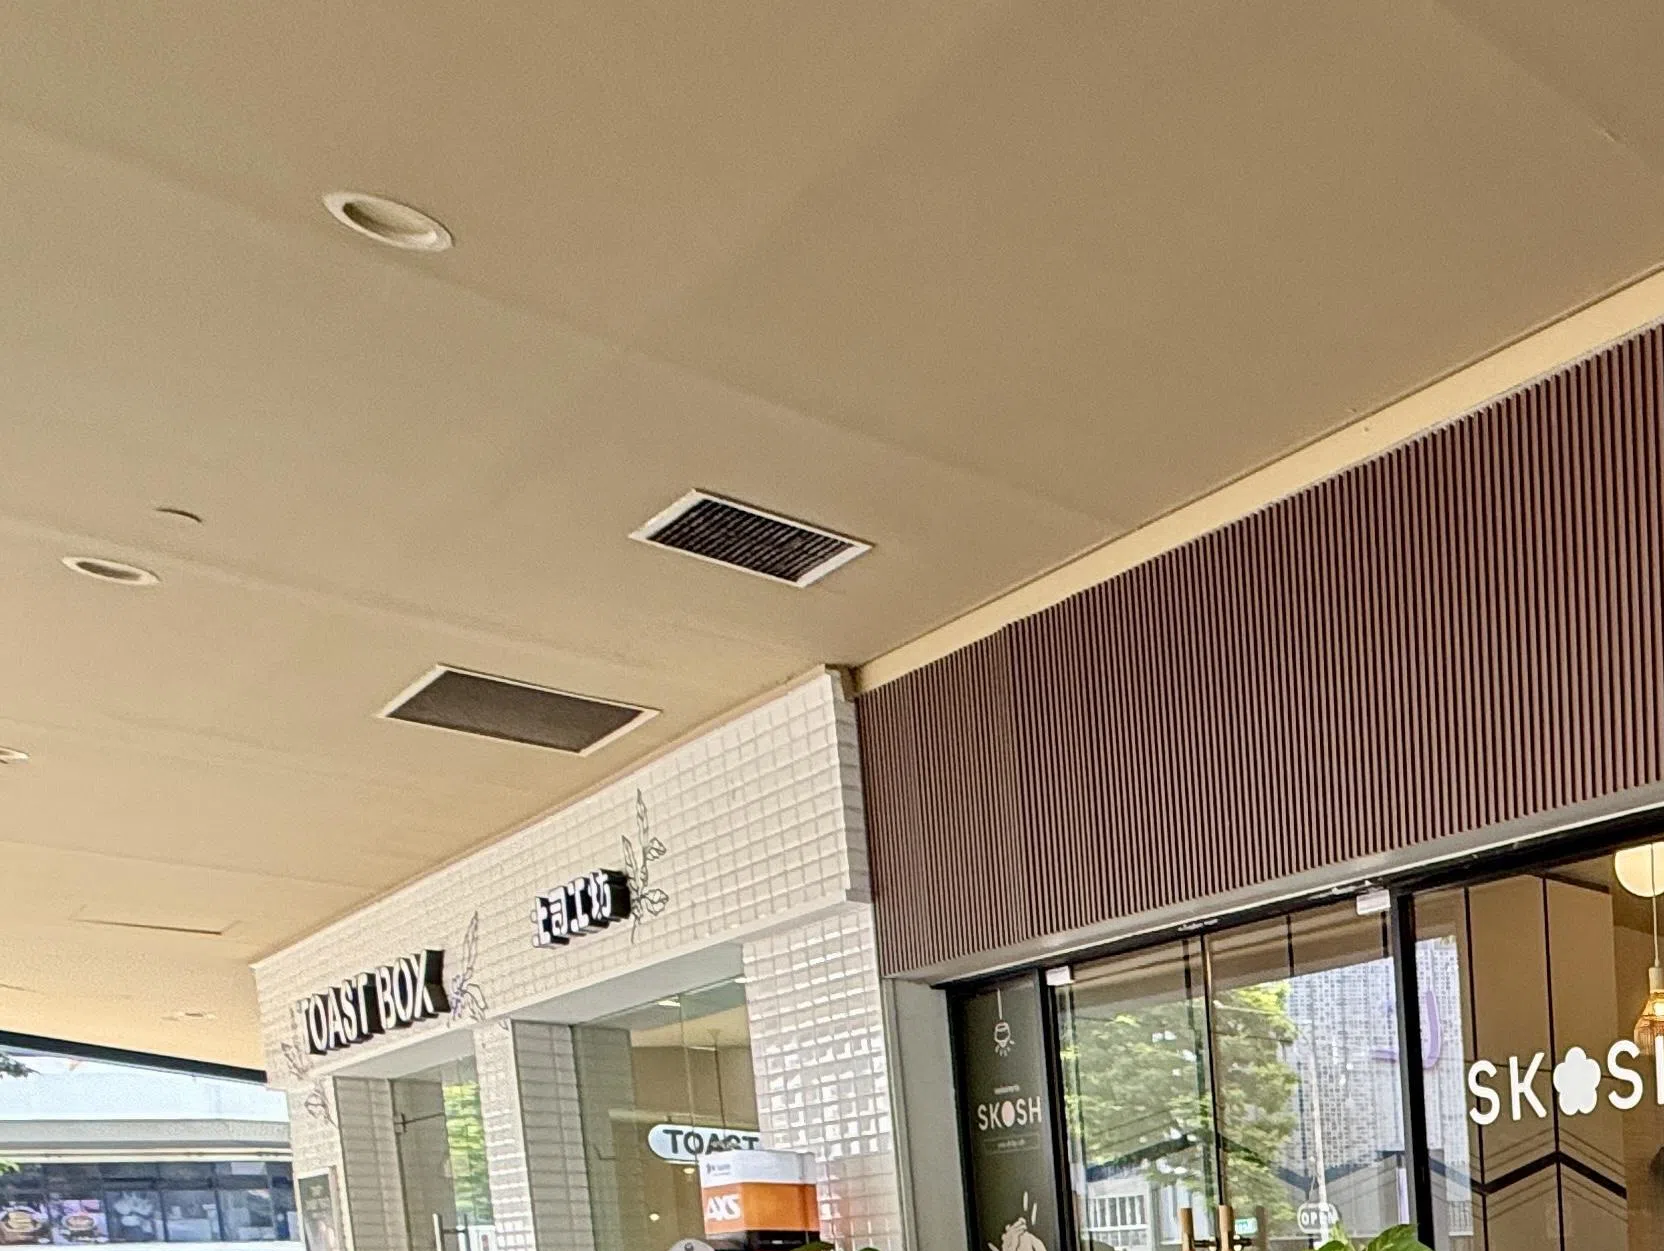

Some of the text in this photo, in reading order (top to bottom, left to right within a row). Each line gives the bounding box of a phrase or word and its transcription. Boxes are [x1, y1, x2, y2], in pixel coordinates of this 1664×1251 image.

[297, 949, 440, 1055] TOAST BOX
[707, 1193, 741, 1221] AXS
